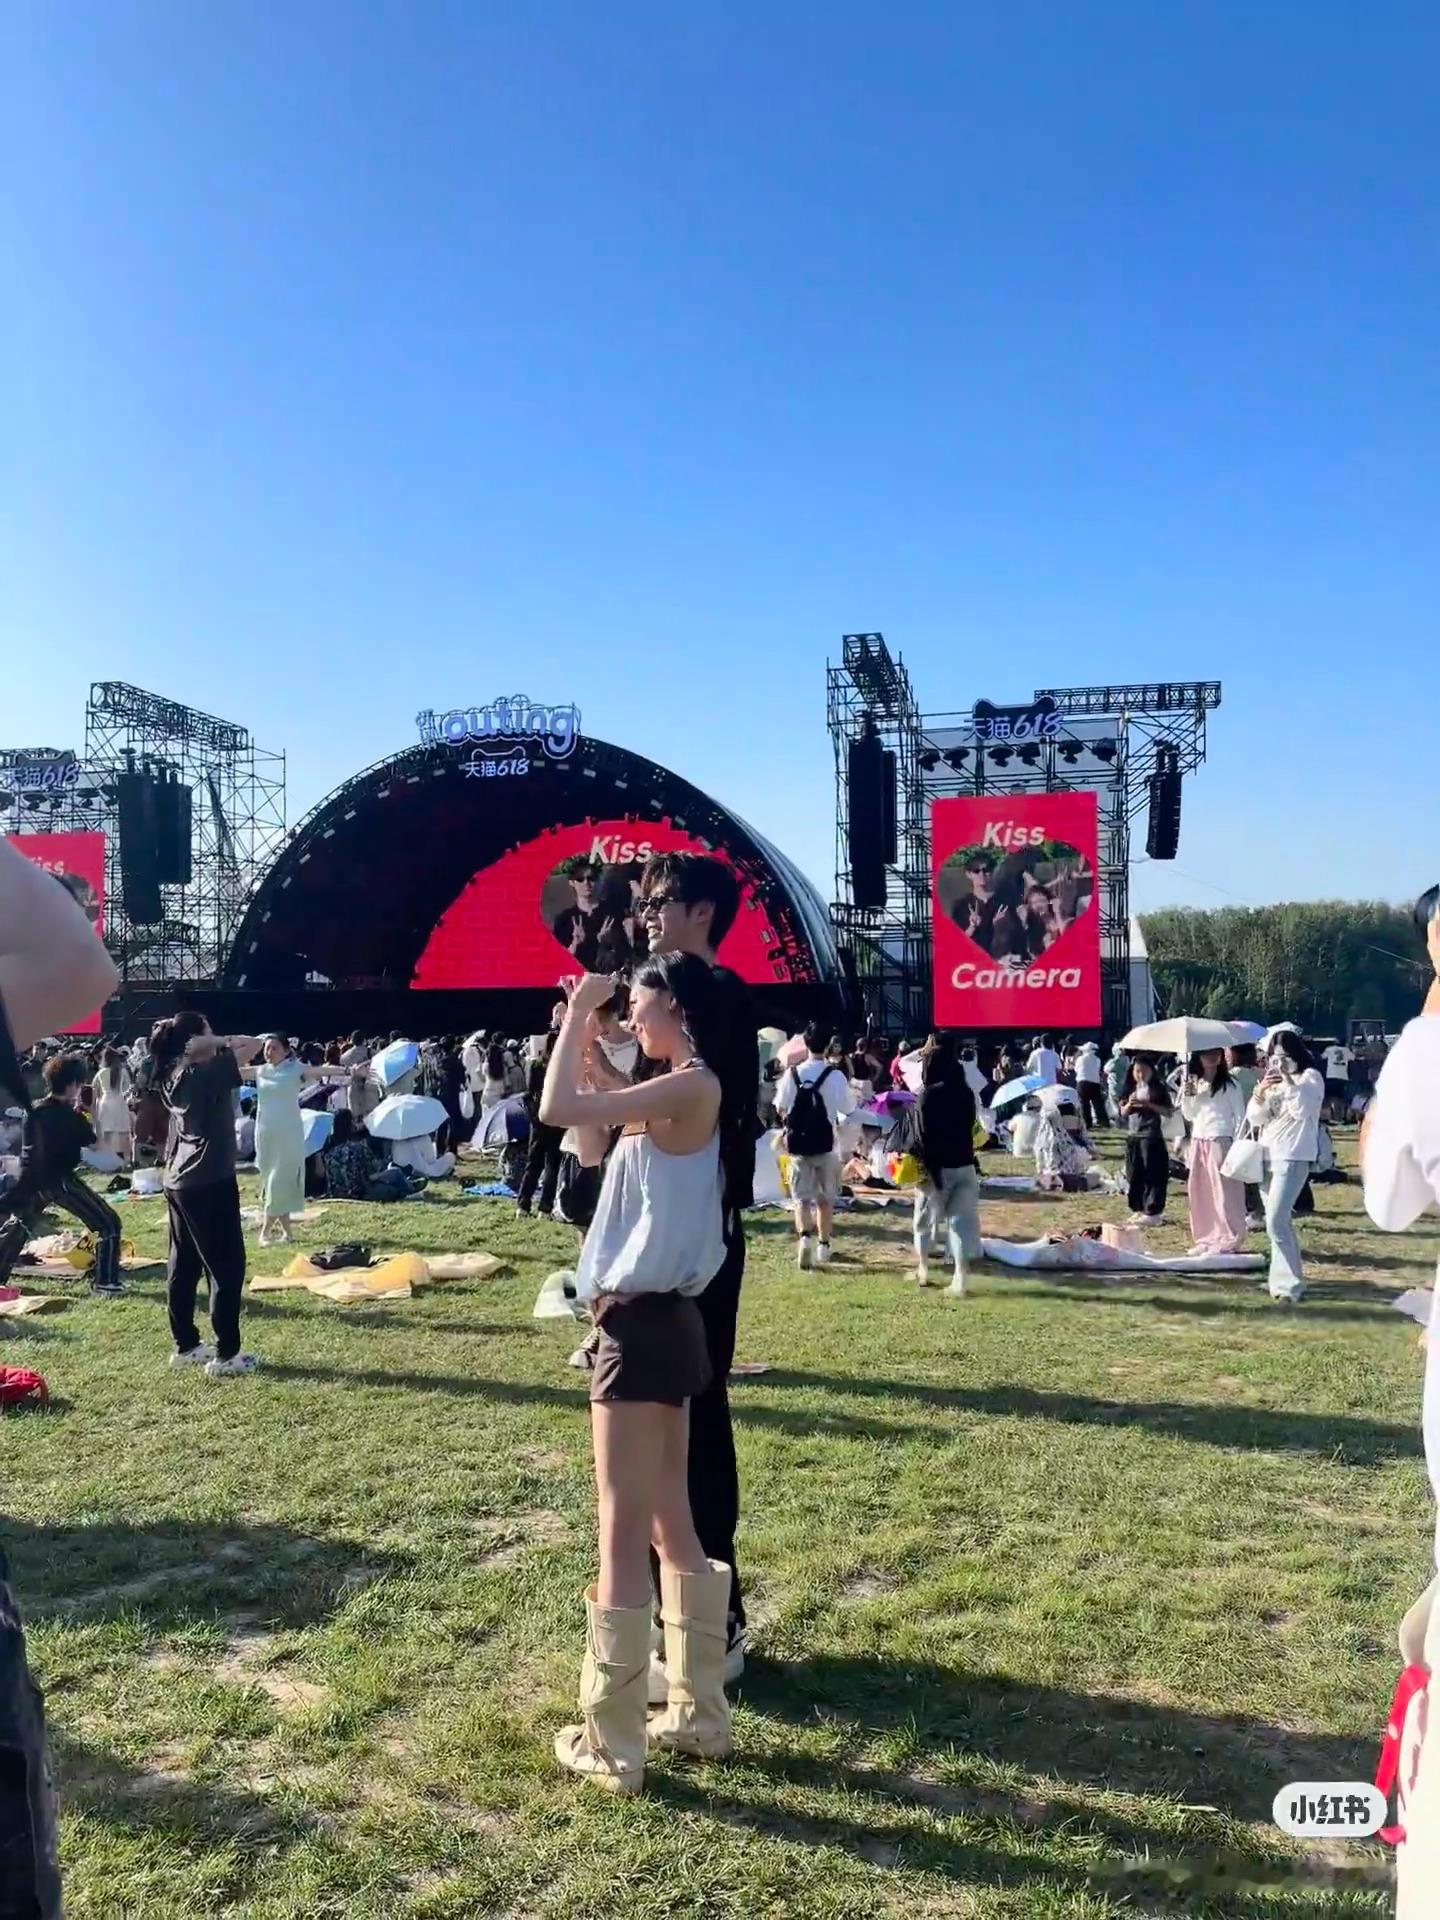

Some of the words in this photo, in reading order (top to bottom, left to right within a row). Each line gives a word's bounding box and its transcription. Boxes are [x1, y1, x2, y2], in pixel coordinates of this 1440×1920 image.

[963, 711, 1062, 741] 天猫618
[4, 761, 80, 786] 天猫618
[464, 758, 531, 778] 天猫618
[982, 821, 1045, 848] Kiss
[588, 835, 653, 864] Kiss
[951, 963, 1081, 990] Camera
